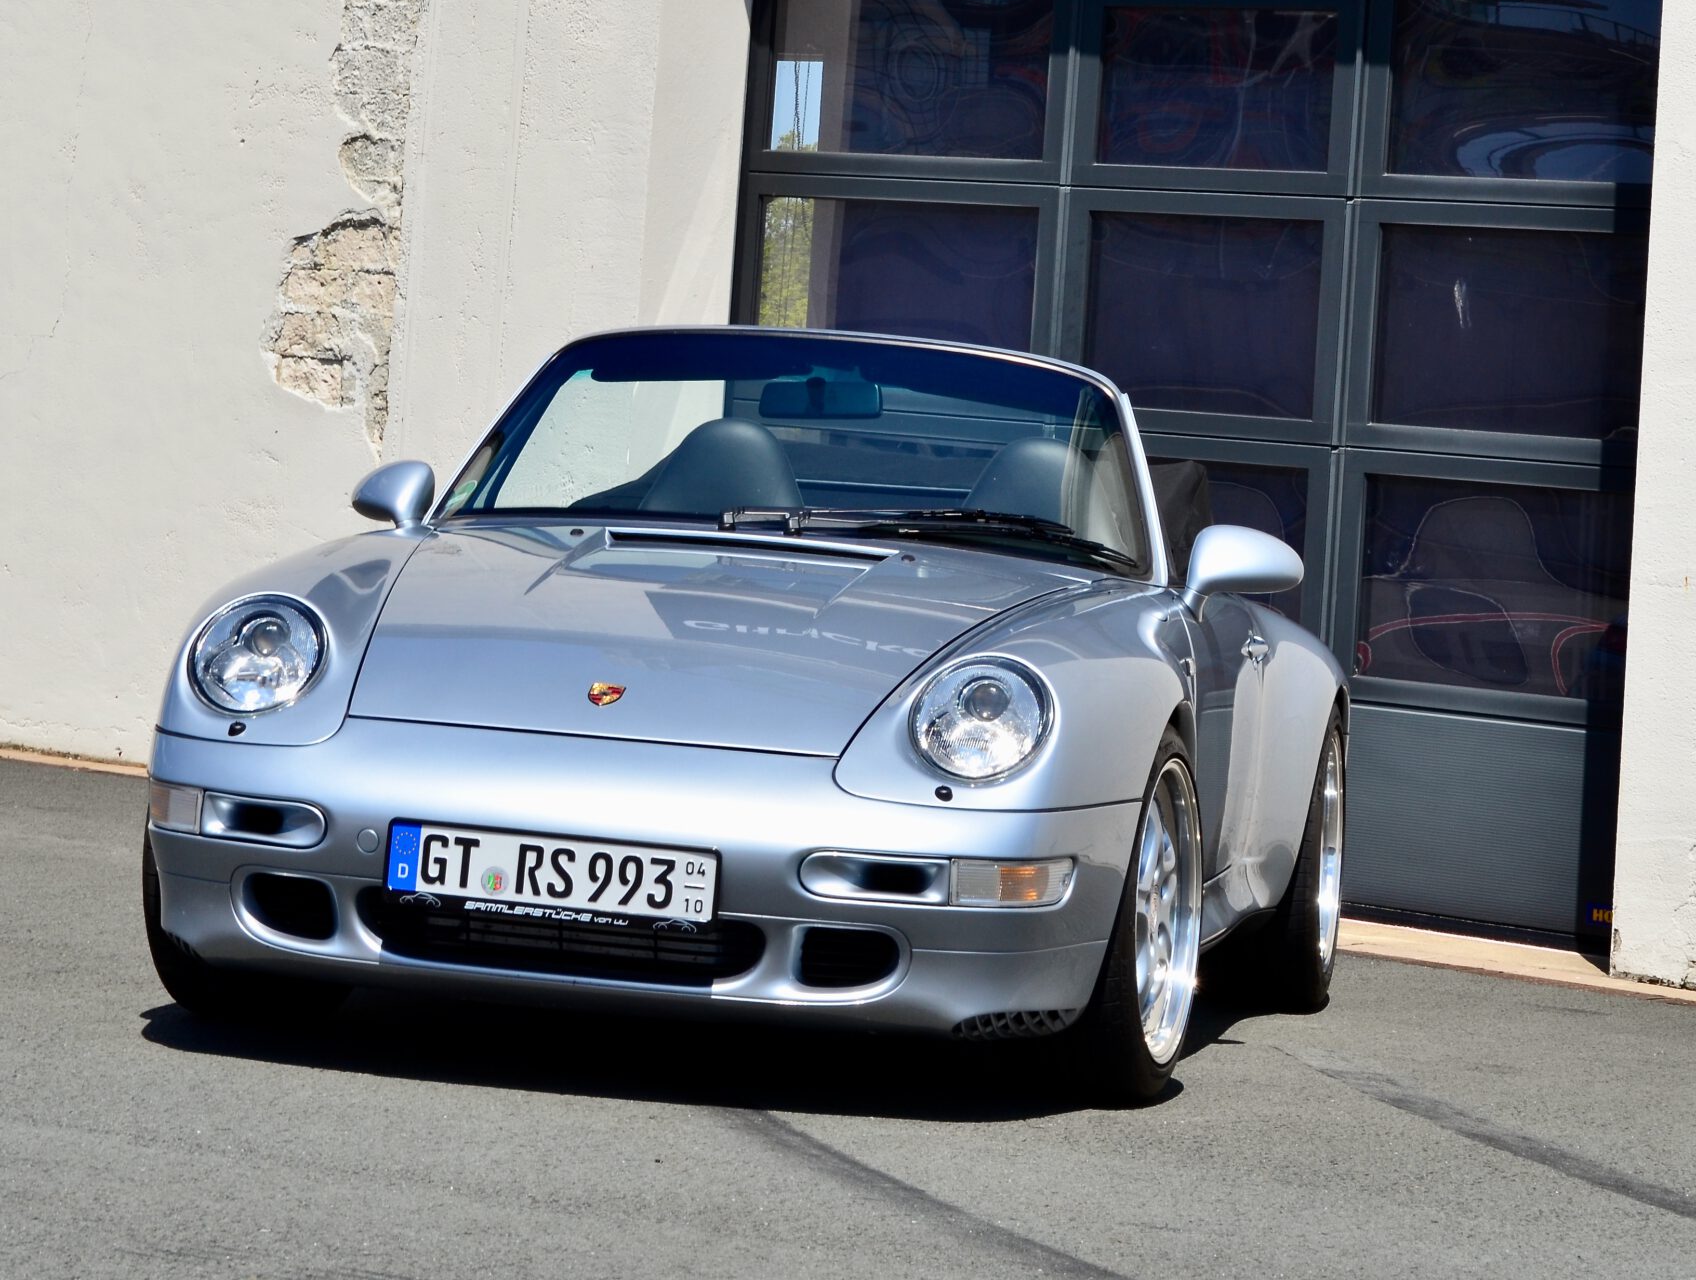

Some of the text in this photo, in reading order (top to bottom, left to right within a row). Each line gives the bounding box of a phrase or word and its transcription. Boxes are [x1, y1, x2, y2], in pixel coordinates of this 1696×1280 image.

[397, 862, 409, 879] D
[420, 833, 676, 910] GT RS 993
[685, 861, 706, 877] 04
[684, 898, 703, 914] 10
